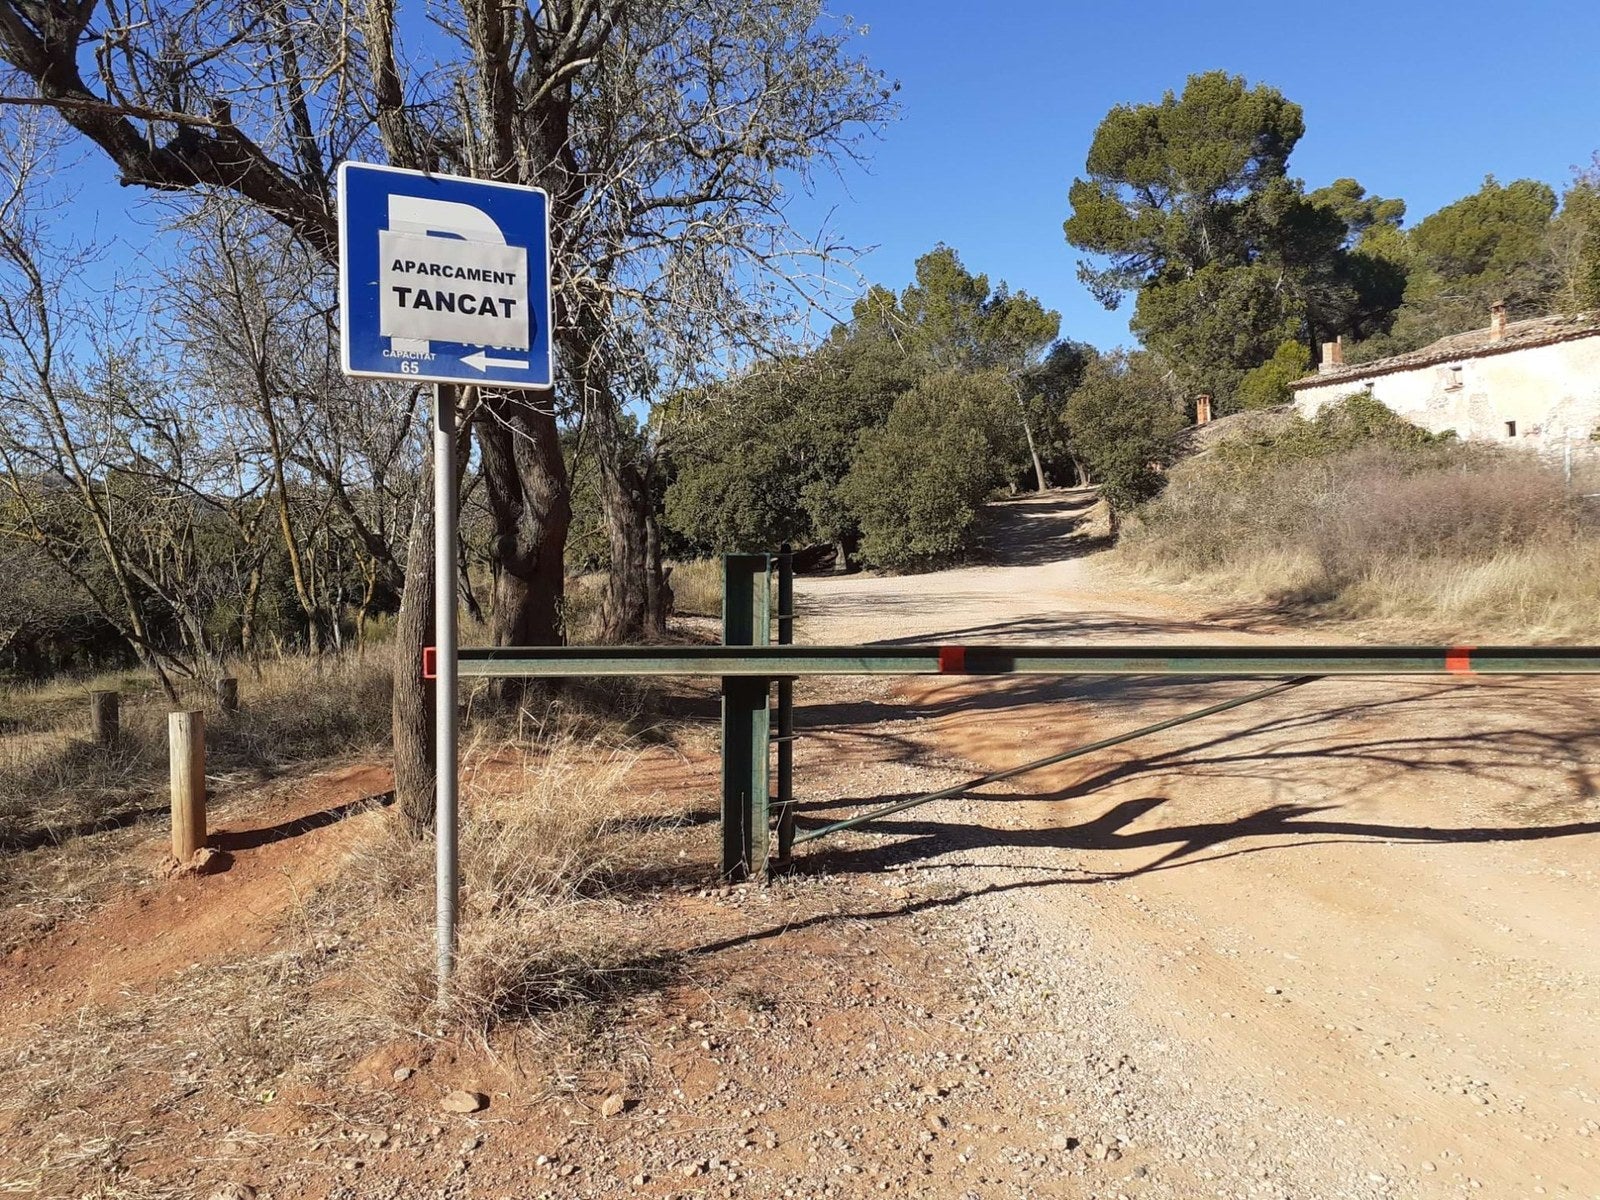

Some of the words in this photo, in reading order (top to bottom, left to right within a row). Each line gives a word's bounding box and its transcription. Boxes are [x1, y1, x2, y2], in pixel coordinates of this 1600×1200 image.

[391, 259, 516, 286] APARCAMENT
[392, 286, 517, 319] TANCAT
[382, 350, 437, 362] CAPACITAT
[400, 360, 419, 374] 65
